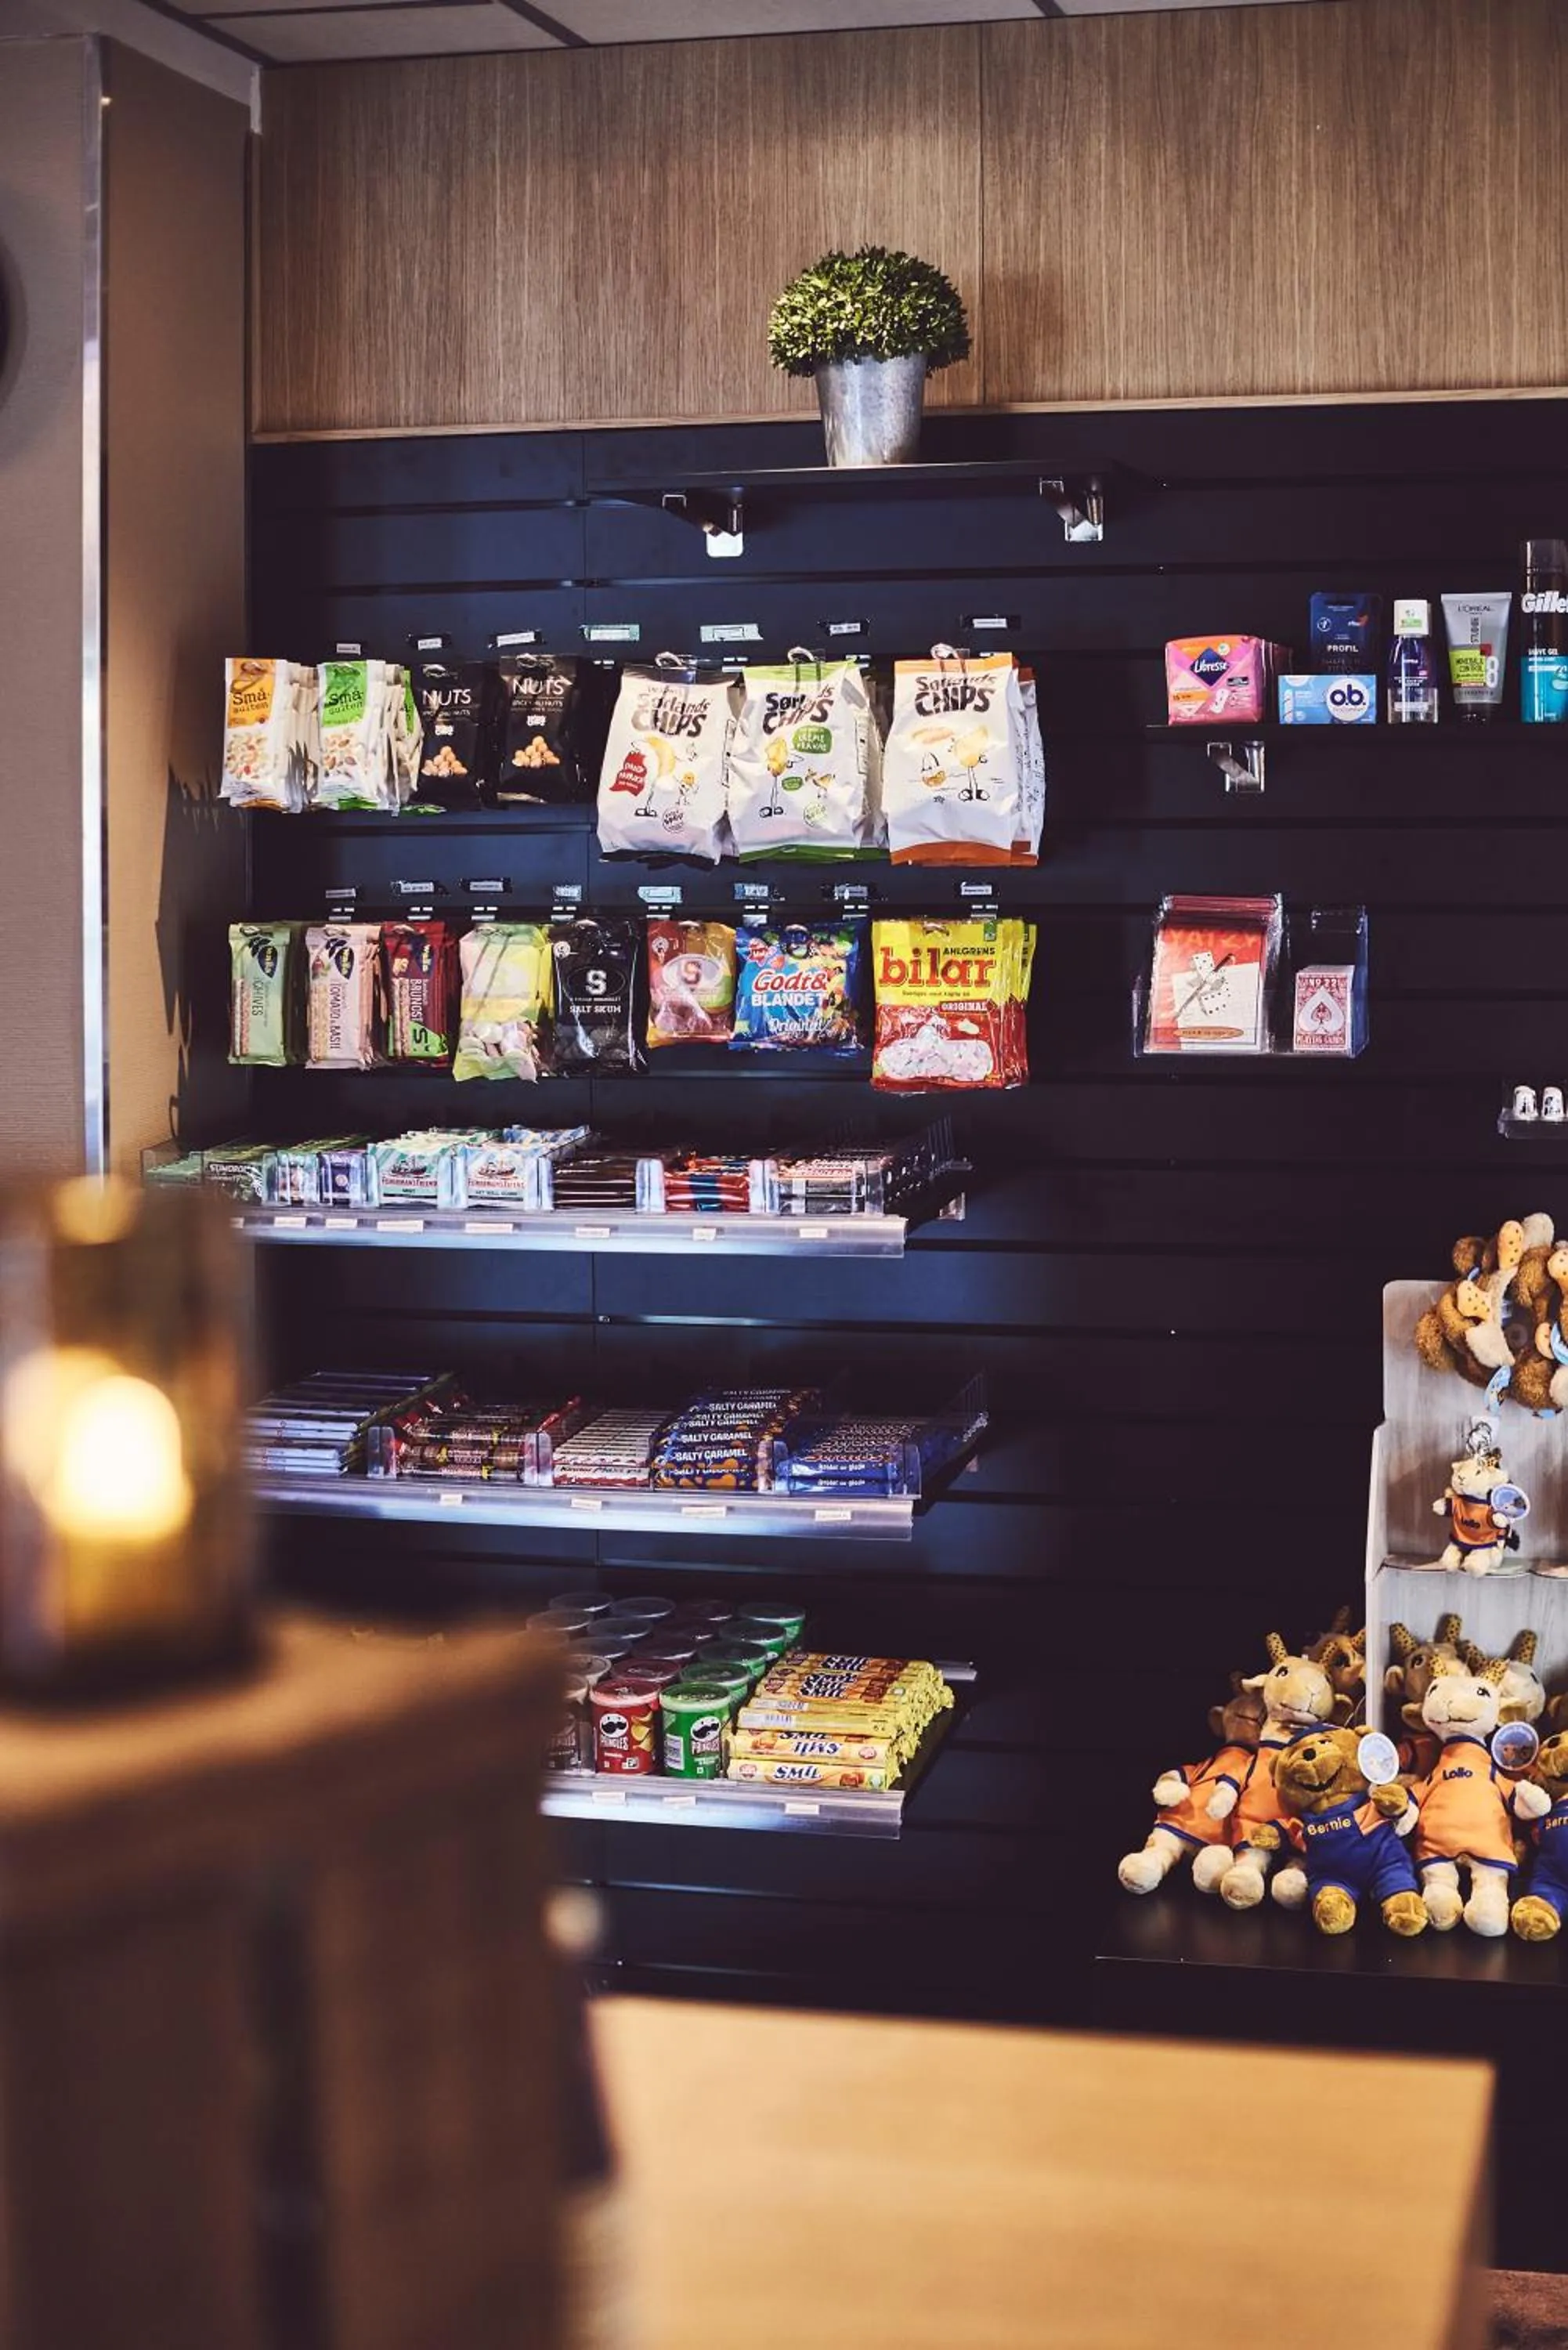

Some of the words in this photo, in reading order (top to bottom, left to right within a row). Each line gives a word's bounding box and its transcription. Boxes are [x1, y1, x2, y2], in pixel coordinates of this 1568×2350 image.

[1194, 659, 1228, 673] Libresse
[512, 677, 565, 695] NUTS
[422, 689, 471, 706] NUTS
[914, 685, 995, 717] CHIPS
[1330, 684, 1367, 706] o.b.
[630, 709, 707, 737] CHIPS
[878, 945, 996, 988] bilar
[330, 983, 341, 1020] TOMATO
[752, 992, 824, 1007] BLANDET
[941, 1001, 988, 1012] ORIGINAL
[680, 1432, 709, 1443] SALTY
[710, 1431, 753, 1441] CARAMEL
[675, 1451, 703, 1462] SALTY
[704, 1449, 748, 1459] CARAMEL
[601, 1736, 629, 1751] PRINGLES
[1442, 1766, 1473, 1781] Lollo
[1306, 1817, 1352, 1836] Bernie
